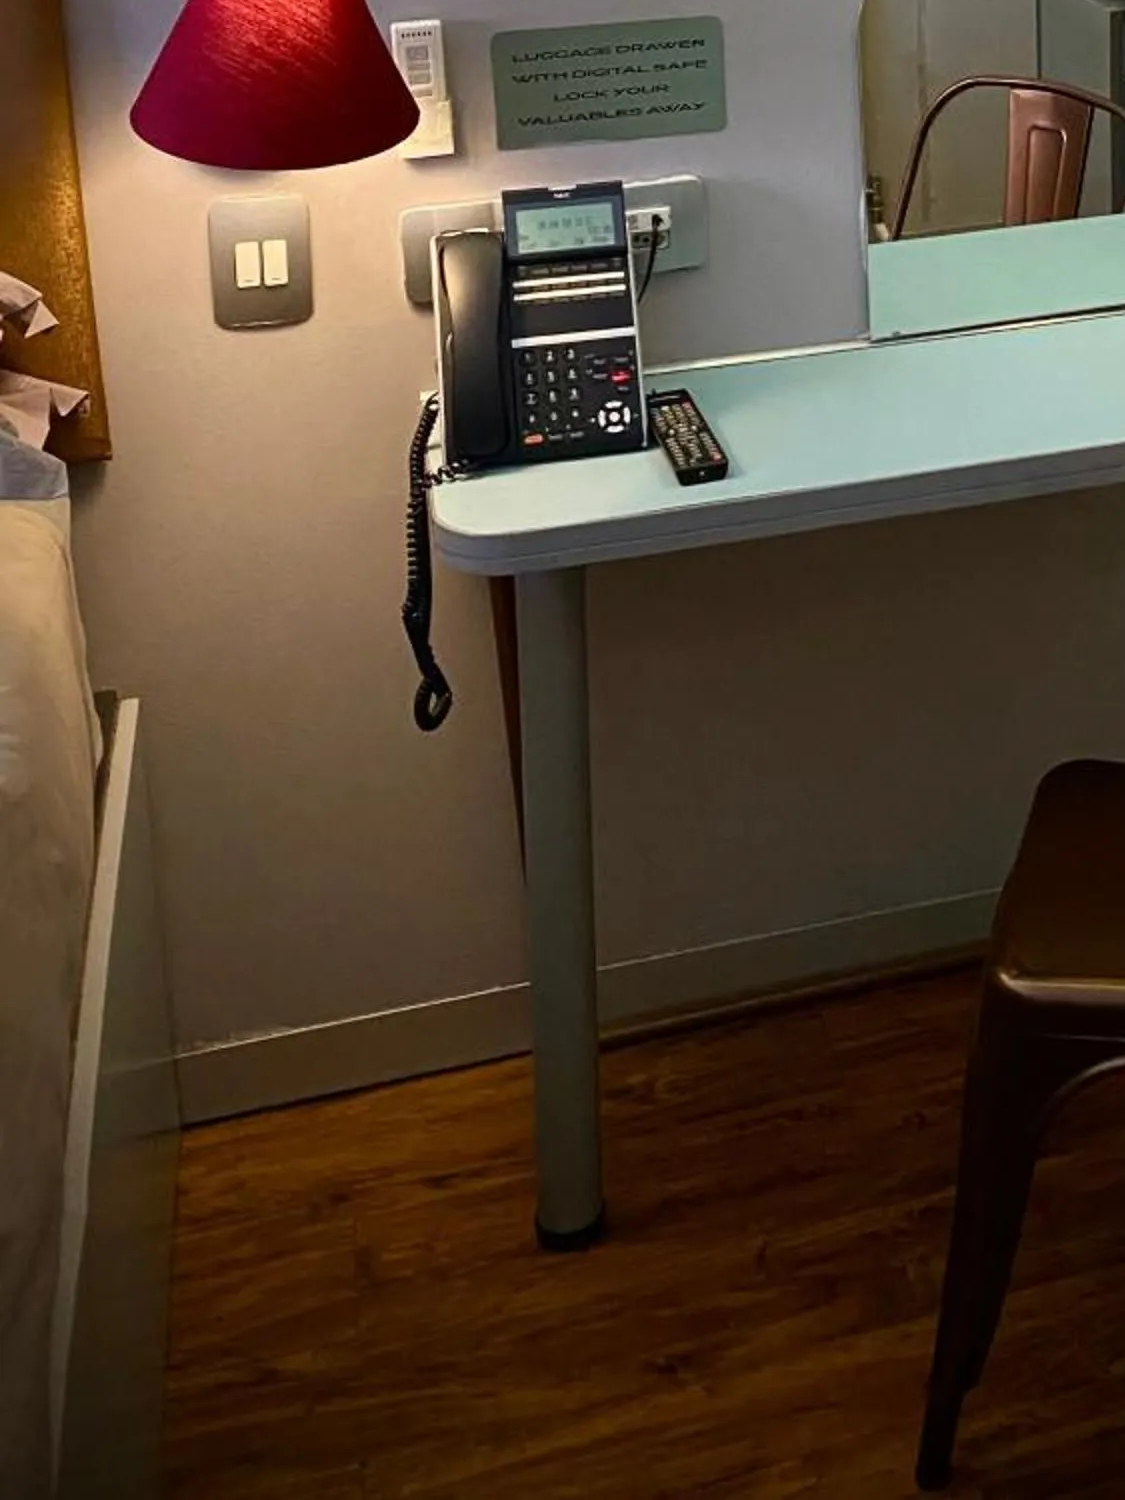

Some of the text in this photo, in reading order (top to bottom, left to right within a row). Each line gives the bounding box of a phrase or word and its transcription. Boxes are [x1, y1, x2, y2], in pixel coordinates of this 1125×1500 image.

[512, 59, 707, 83] WITH DIGITAL SAFE
[554, 83, 670, 102] LOCK YOUR
[518, 101, 705, 127] VALUABLES AWAY
